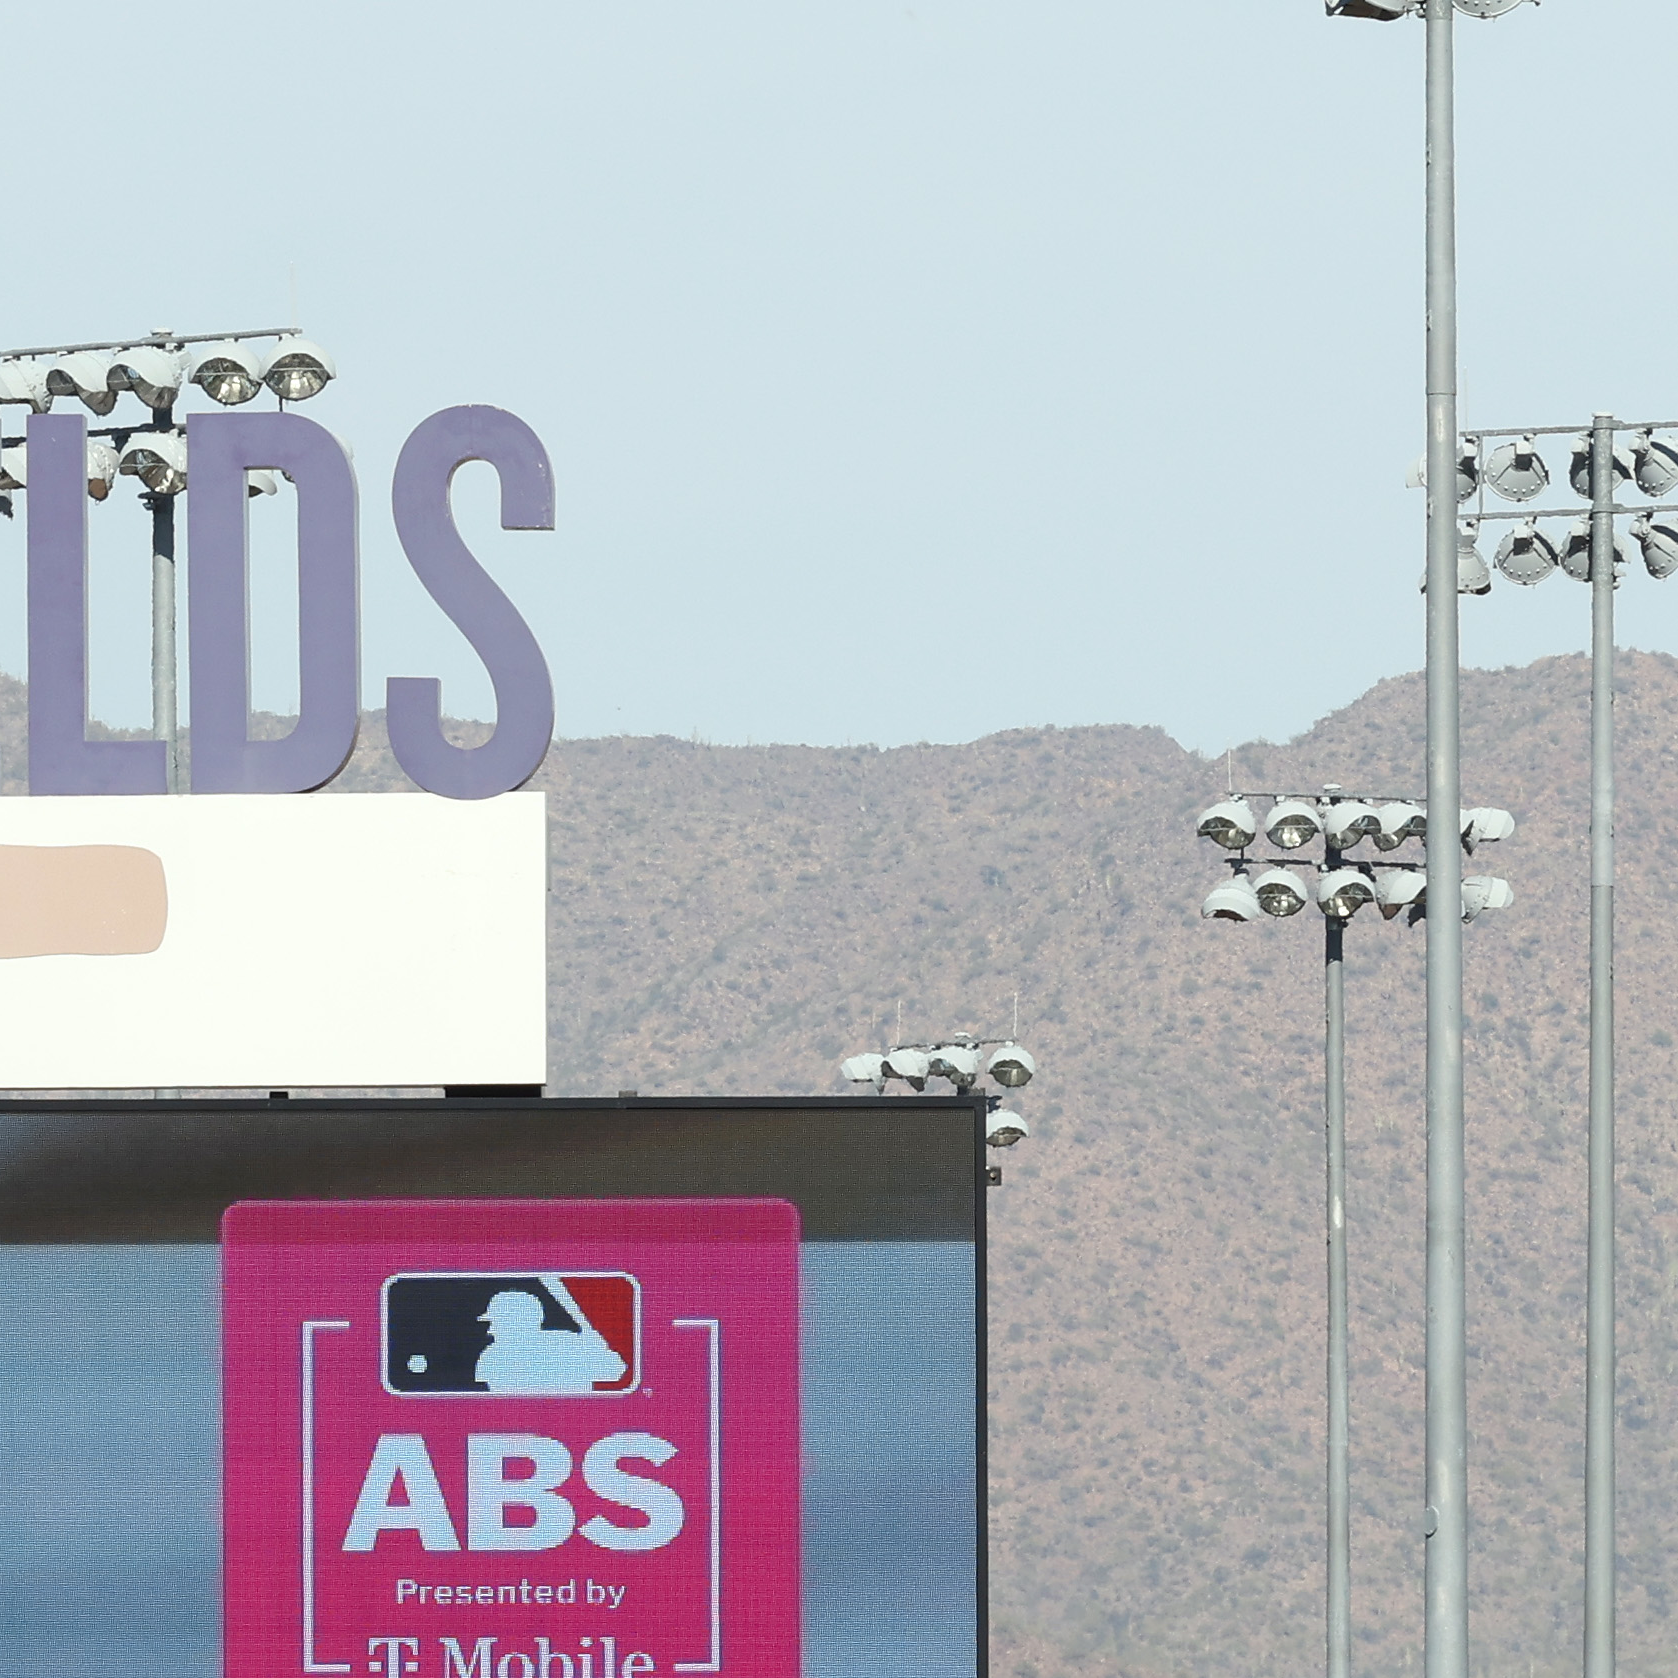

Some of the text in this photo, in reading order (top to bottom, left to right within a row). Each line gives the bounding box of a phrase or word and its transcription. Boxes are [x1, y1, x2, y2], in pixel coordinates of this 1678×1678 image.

[341, 1431, 685, 1552] ABS
[396, 1578, 626, 1609] Presented by
